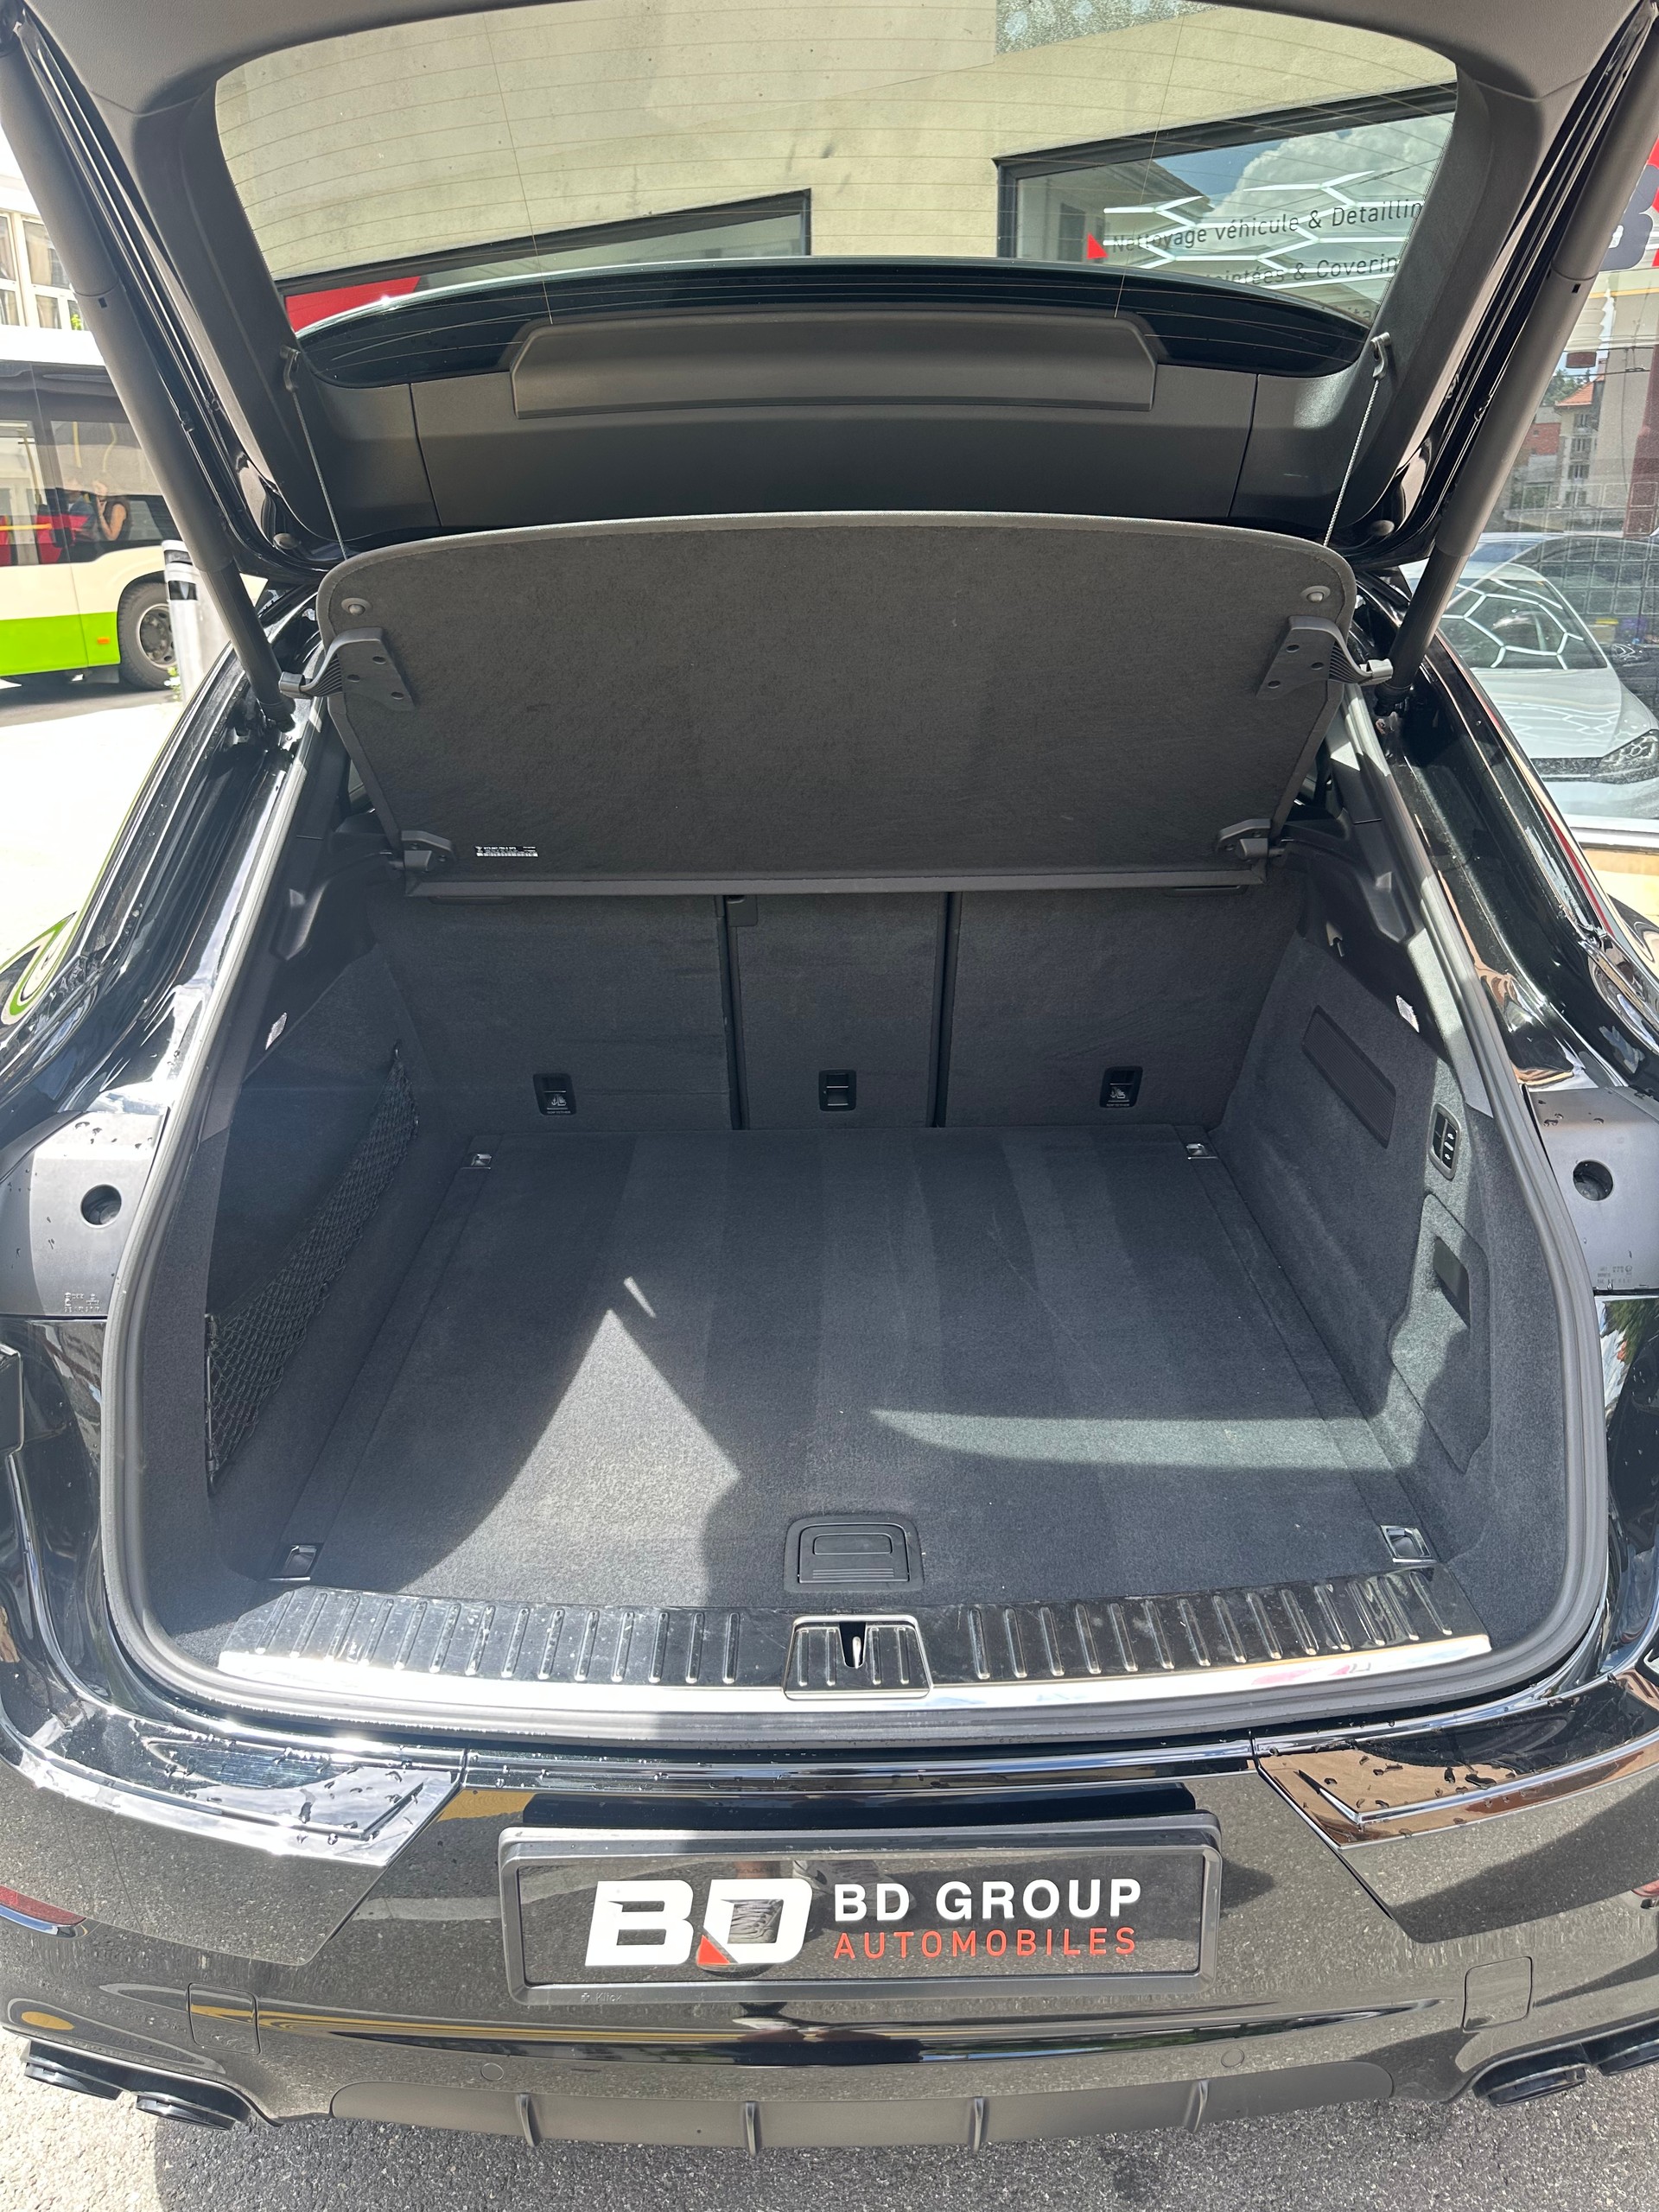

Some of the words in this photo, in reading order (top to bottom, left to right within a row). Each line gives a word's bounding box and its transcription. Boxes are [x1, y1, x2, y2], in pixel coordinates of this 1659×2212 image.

[1113, 230, 1206, 253] Nettoyage
[1215, 214, 1299, 240] véhicule
[1308, 210, 1321, 229] &
[1294, 262, 1306, 281] &
[834, 1884, 910, 1922] BD
[935, 1878, 1142, 1921] GROUP
[834, 1927, 1136, 1960] AUTOMOBILES
